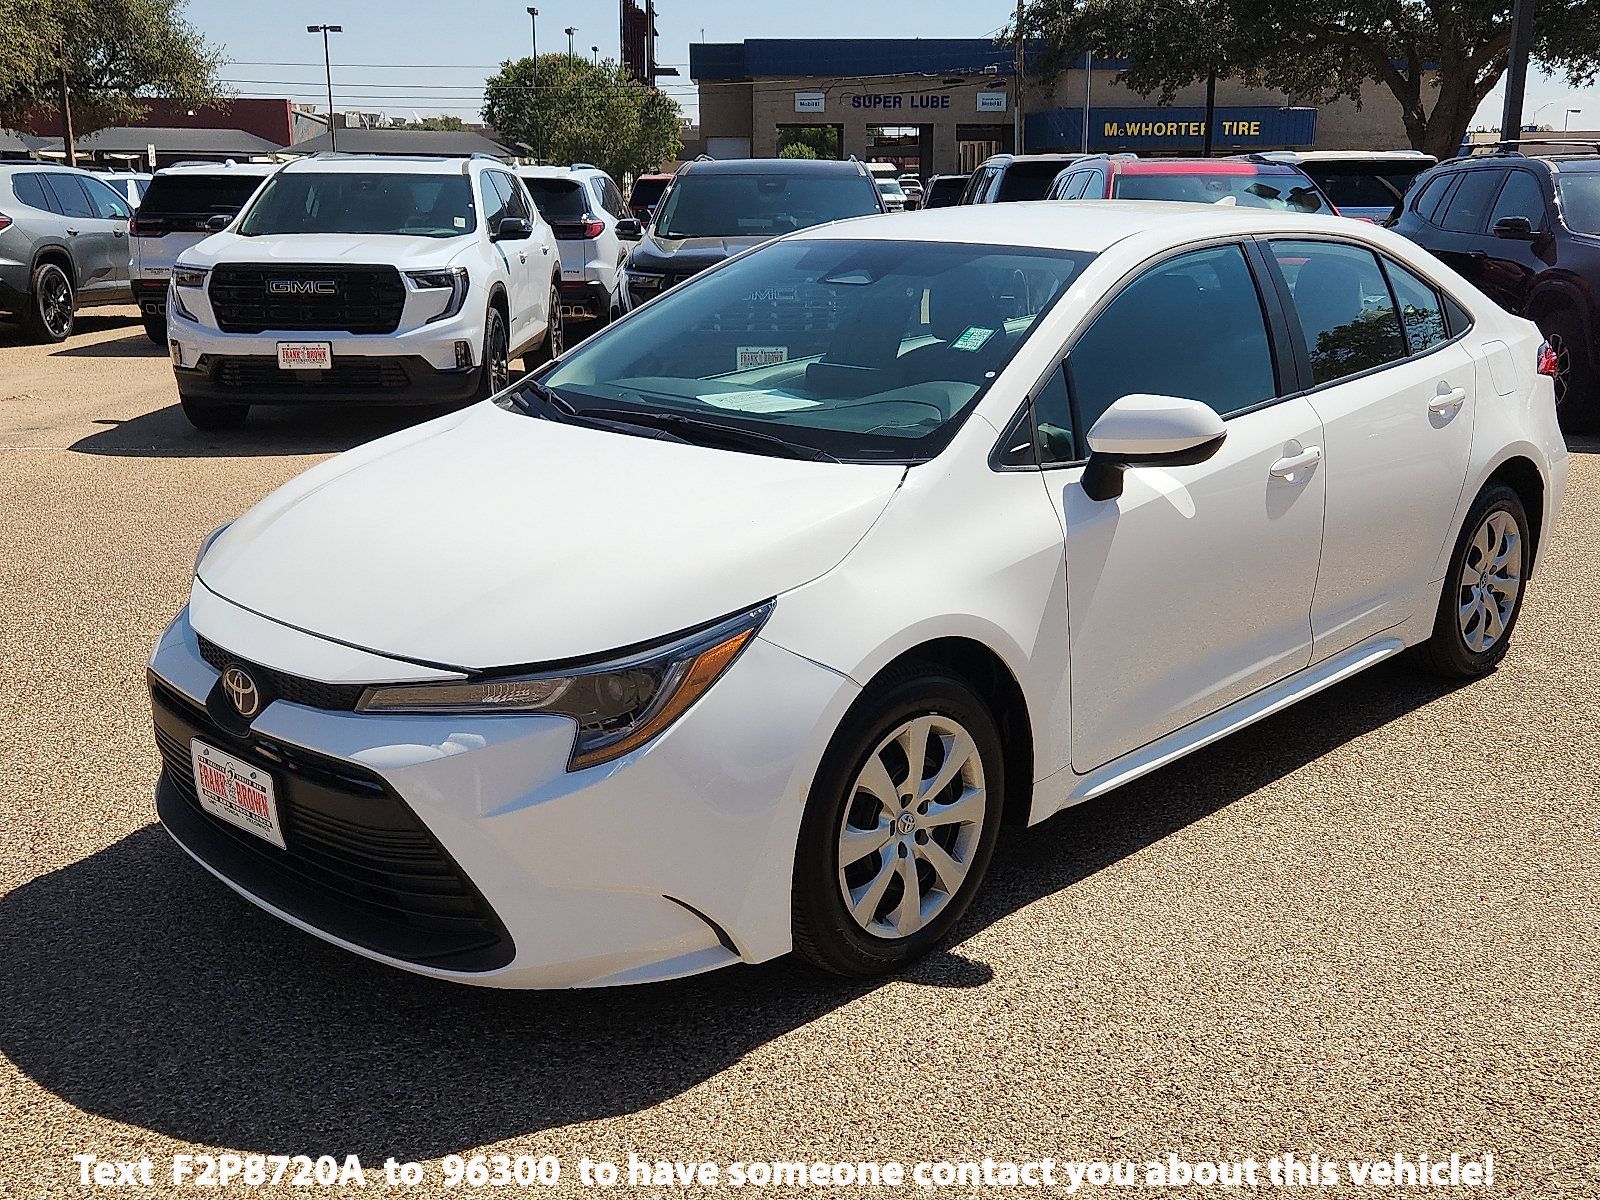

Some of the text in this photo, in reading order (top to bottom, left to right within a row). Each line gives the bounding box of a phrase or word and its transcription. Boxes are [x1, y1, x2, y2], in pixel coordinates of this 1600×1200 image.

[852, 95, 950, 109] SUPER LUBE
[1222, 121, 1260, 136] TIRE
[270, 280, 335, 294] GMC
[282, 350, 300, 359] FRANK
[198, 762, 229, 799] FRANK
[235, 780, 271, 821] BROWN
